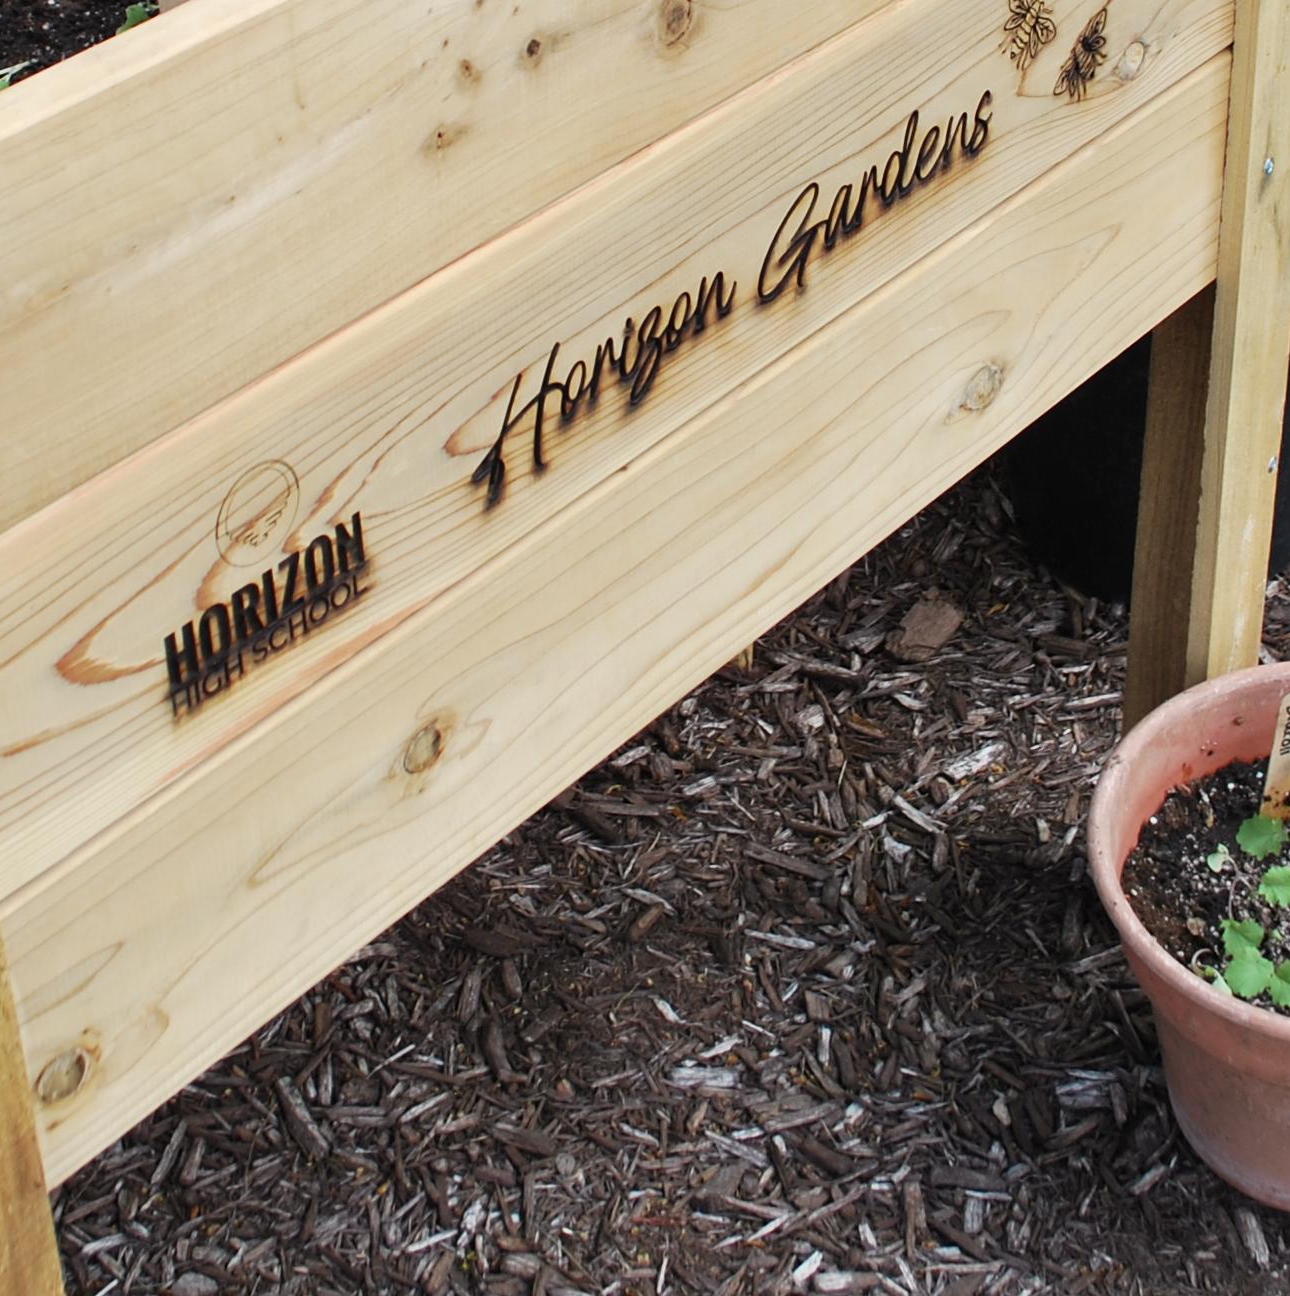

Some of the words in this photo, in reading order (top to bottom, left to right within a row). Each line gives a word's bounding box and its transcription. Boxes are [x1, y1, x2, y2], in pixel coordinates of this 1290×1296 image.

[470, 270, 737, 512] Horizon
[757, 90, 994, 306] Gardens
[164, 511, 368, 688] HORIZON
[170, 650, 246, 718] HIGH
[251, 575, 371, 665] SCHOOL
